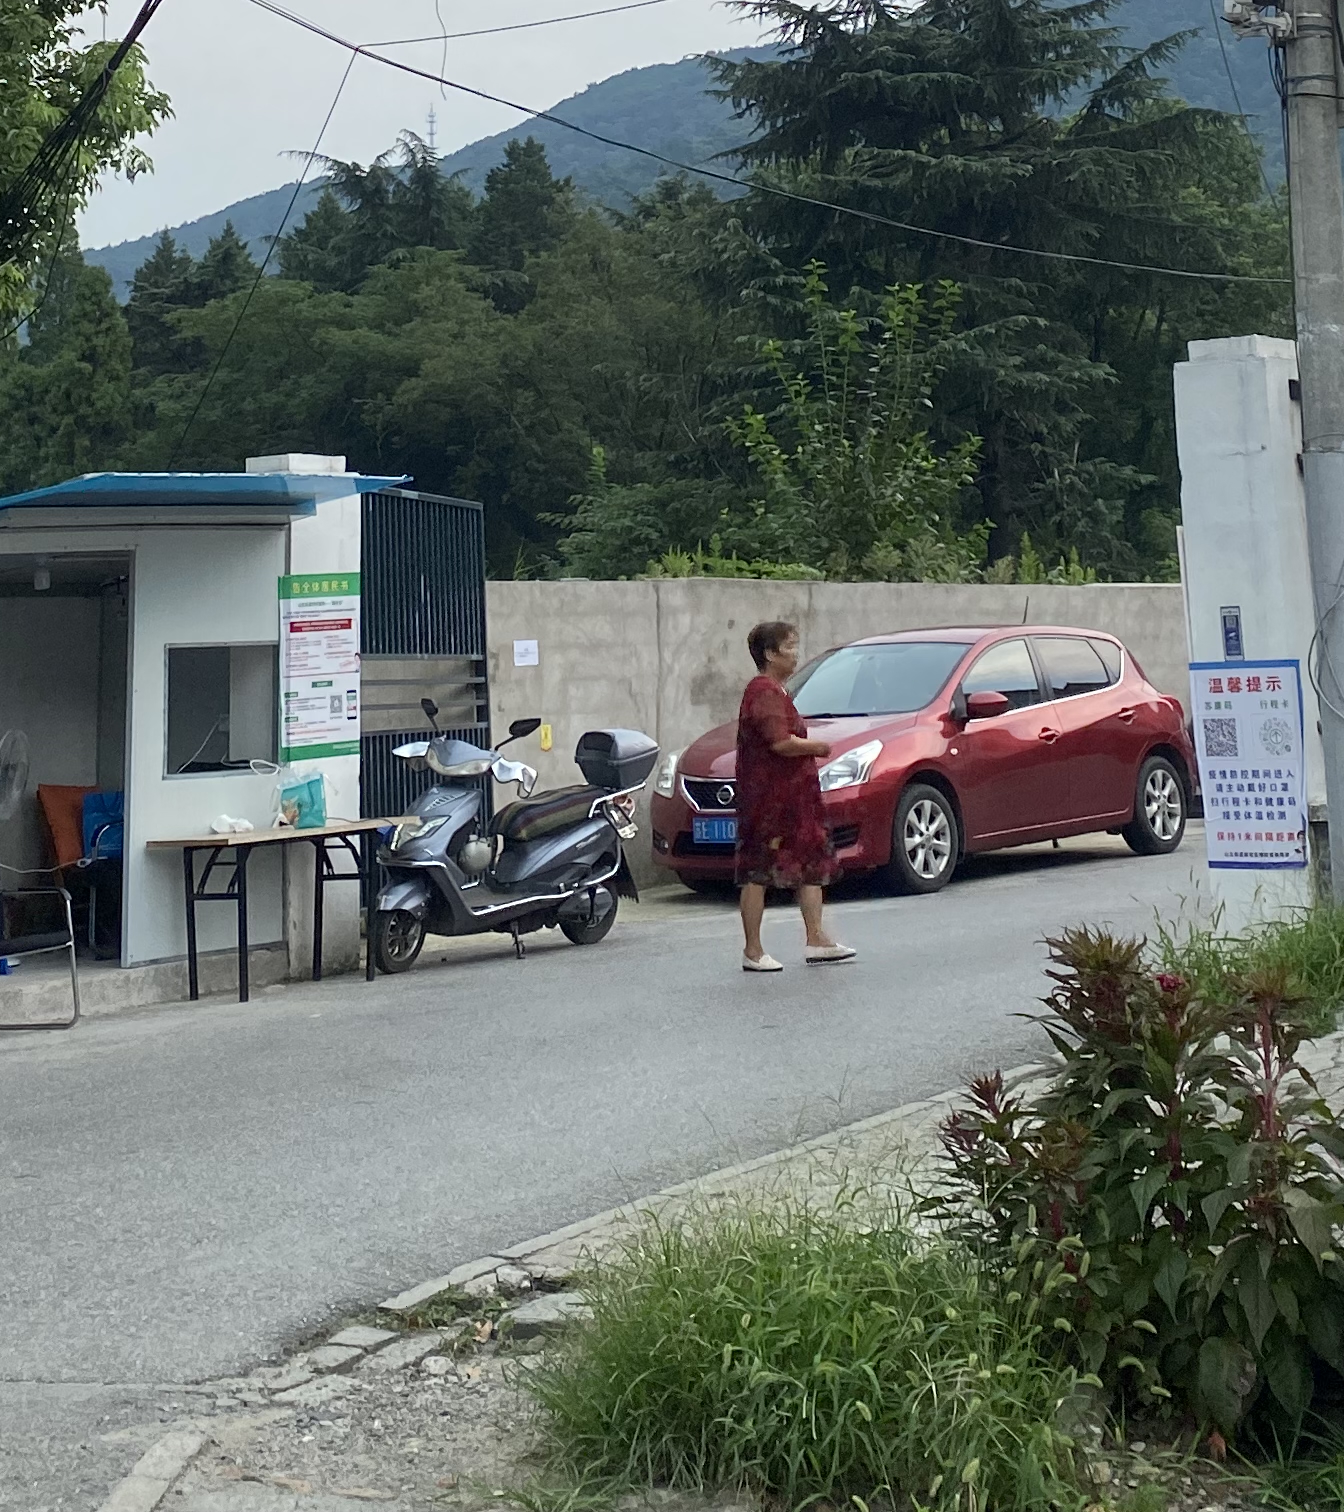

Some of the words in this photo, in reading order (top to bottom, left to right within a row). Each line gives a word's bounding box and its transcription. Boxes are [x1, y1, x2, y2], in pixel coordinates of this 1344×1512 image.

[1208, 675, 1282, 694] 温馨提示
[1259, 699, 1289, 710] 行程卡
[1208, 769, 1295, 780] 疫情防控期间进入
[1215, 782, 1289, 793] 请主动戴好口罩
[1210, 796, 1296, 807] 扫行程卡和健康码
[1222, 810, 1287, 821] 接受体温检测
